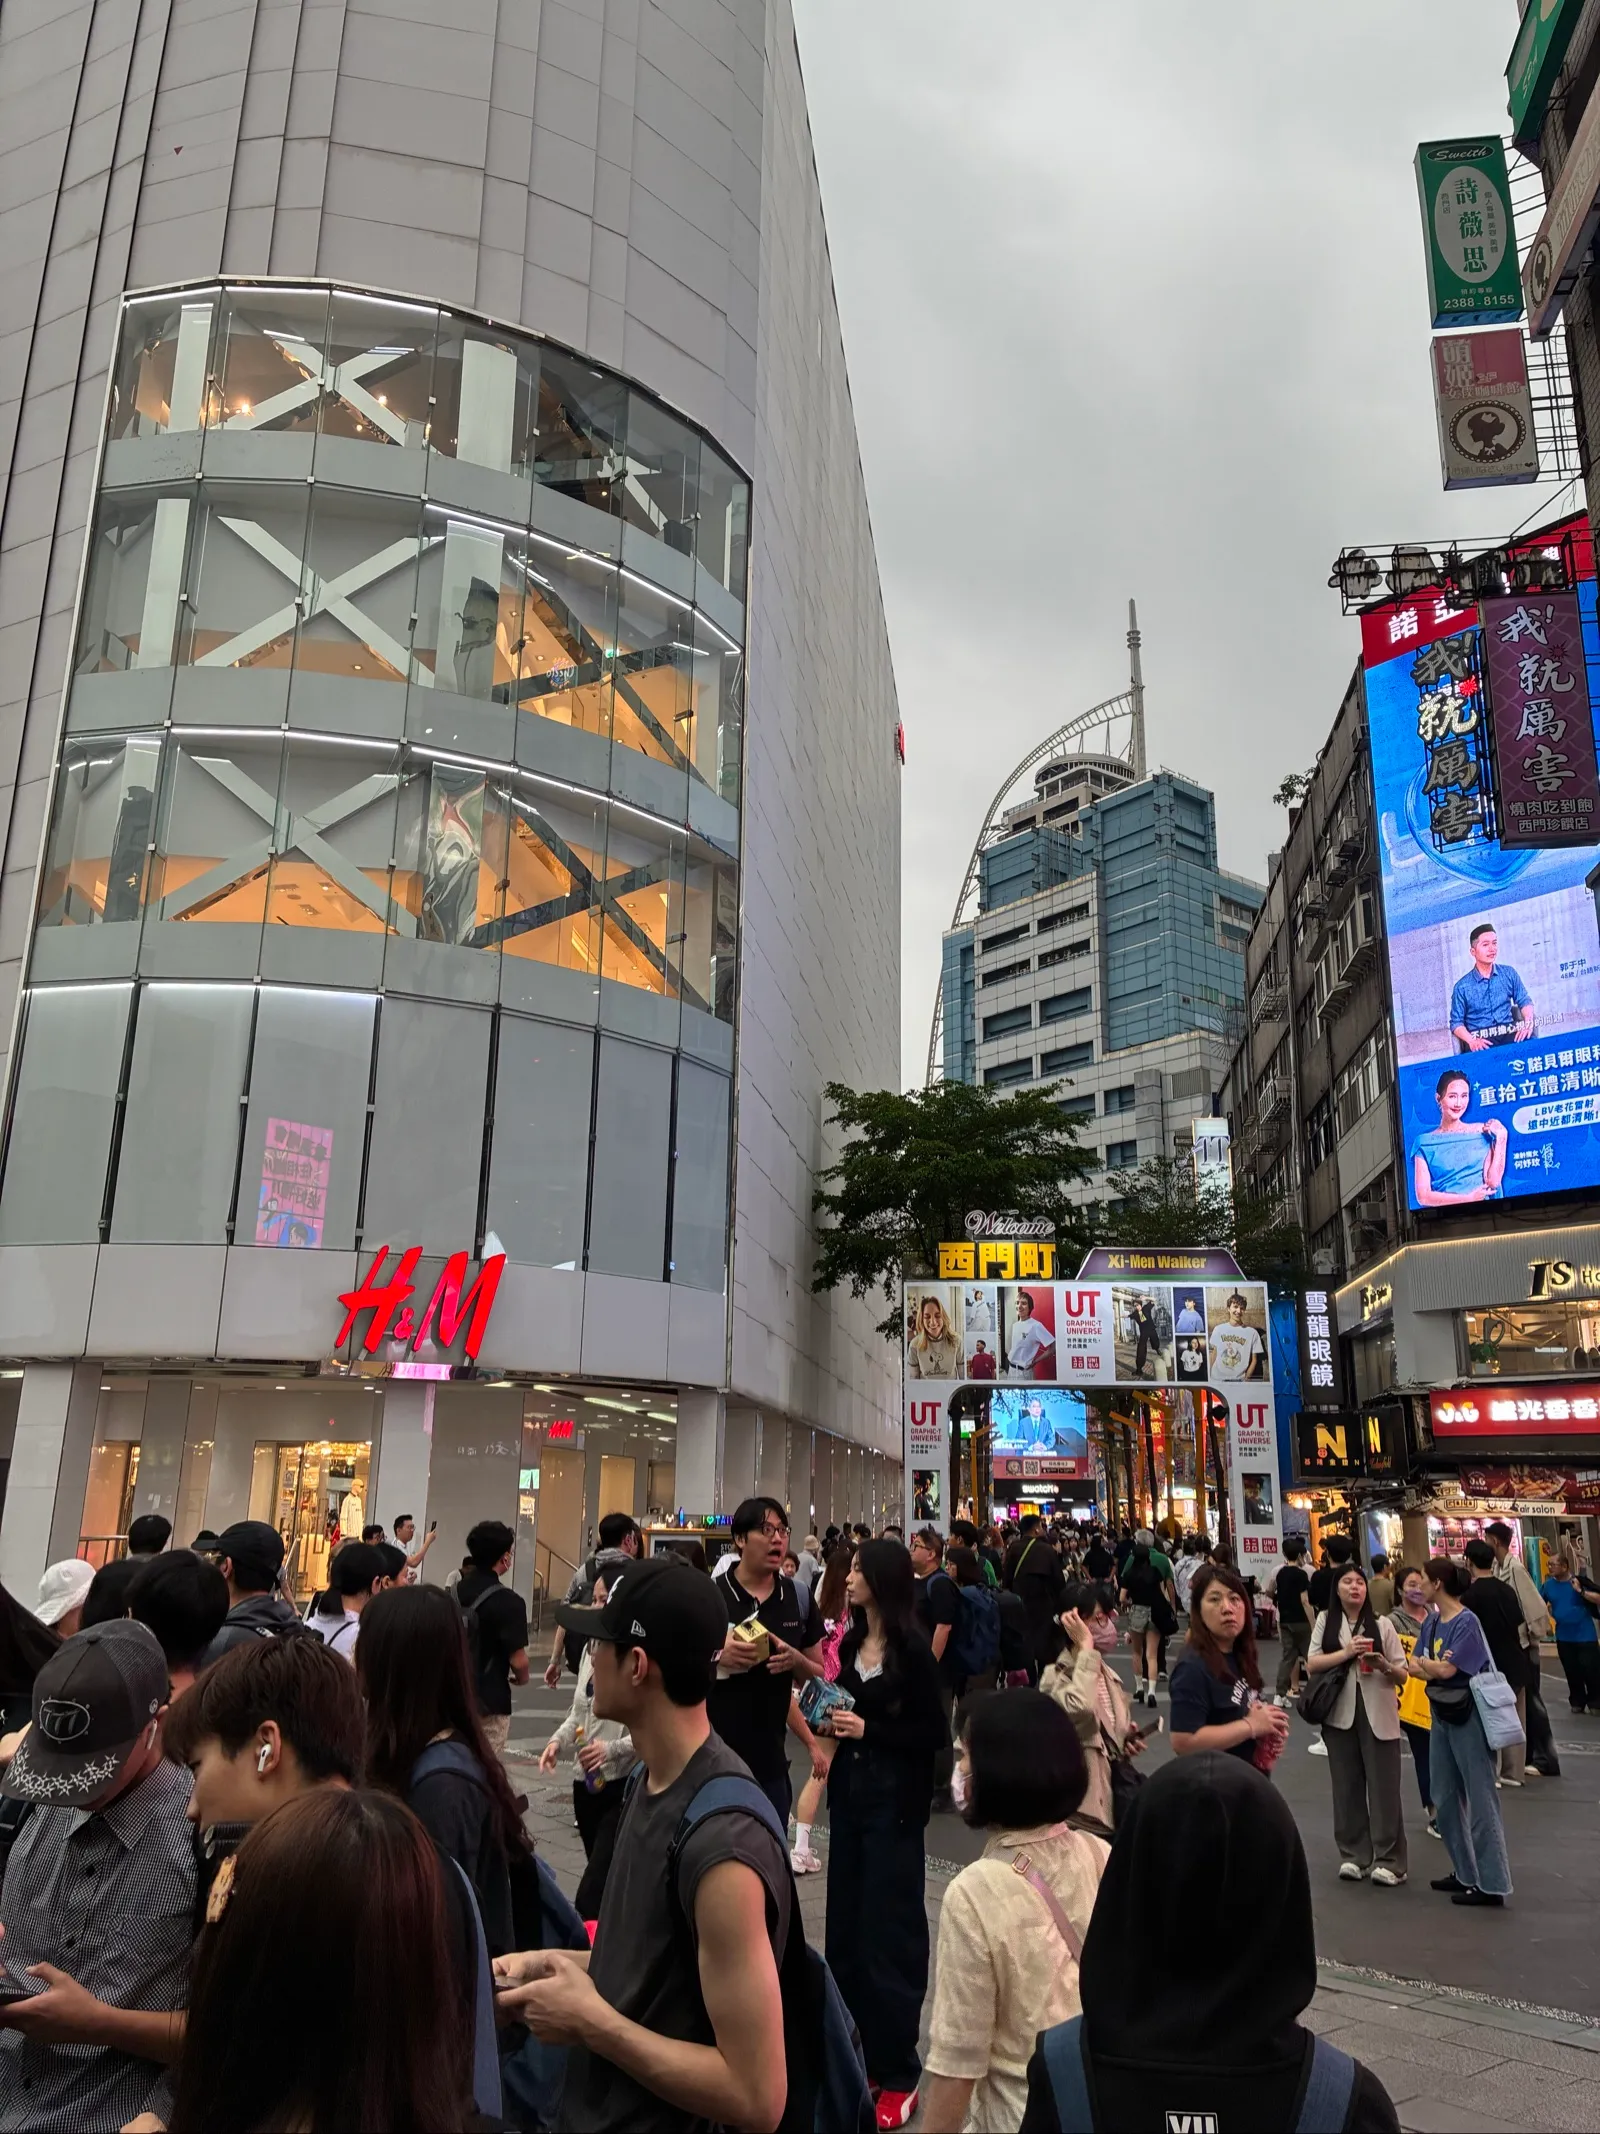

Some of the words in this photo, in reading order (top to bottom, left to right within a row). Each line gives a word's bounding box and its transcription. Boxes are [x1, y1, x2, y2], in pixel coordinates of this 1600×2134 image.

[1454, 177, 1488, 273] 詩薇思
[1509, 798, 1594, 817] 燒肉吃到飽
[964, 1209, 1056, 1236] Welcome
[938, 1242, 1056, 1279] 西門町
[1107, 1253, 1155, 1269] Xi-Men
[335, 1245, 506, 1359] H&M
[1065, 1290, 1101, 1318] UT
[1305, 1291, 1335, 1387] 雪龍眼鏡
[911, 1401, 942, 1426] UT
[1236, 1403, 1268, 1429] UT
